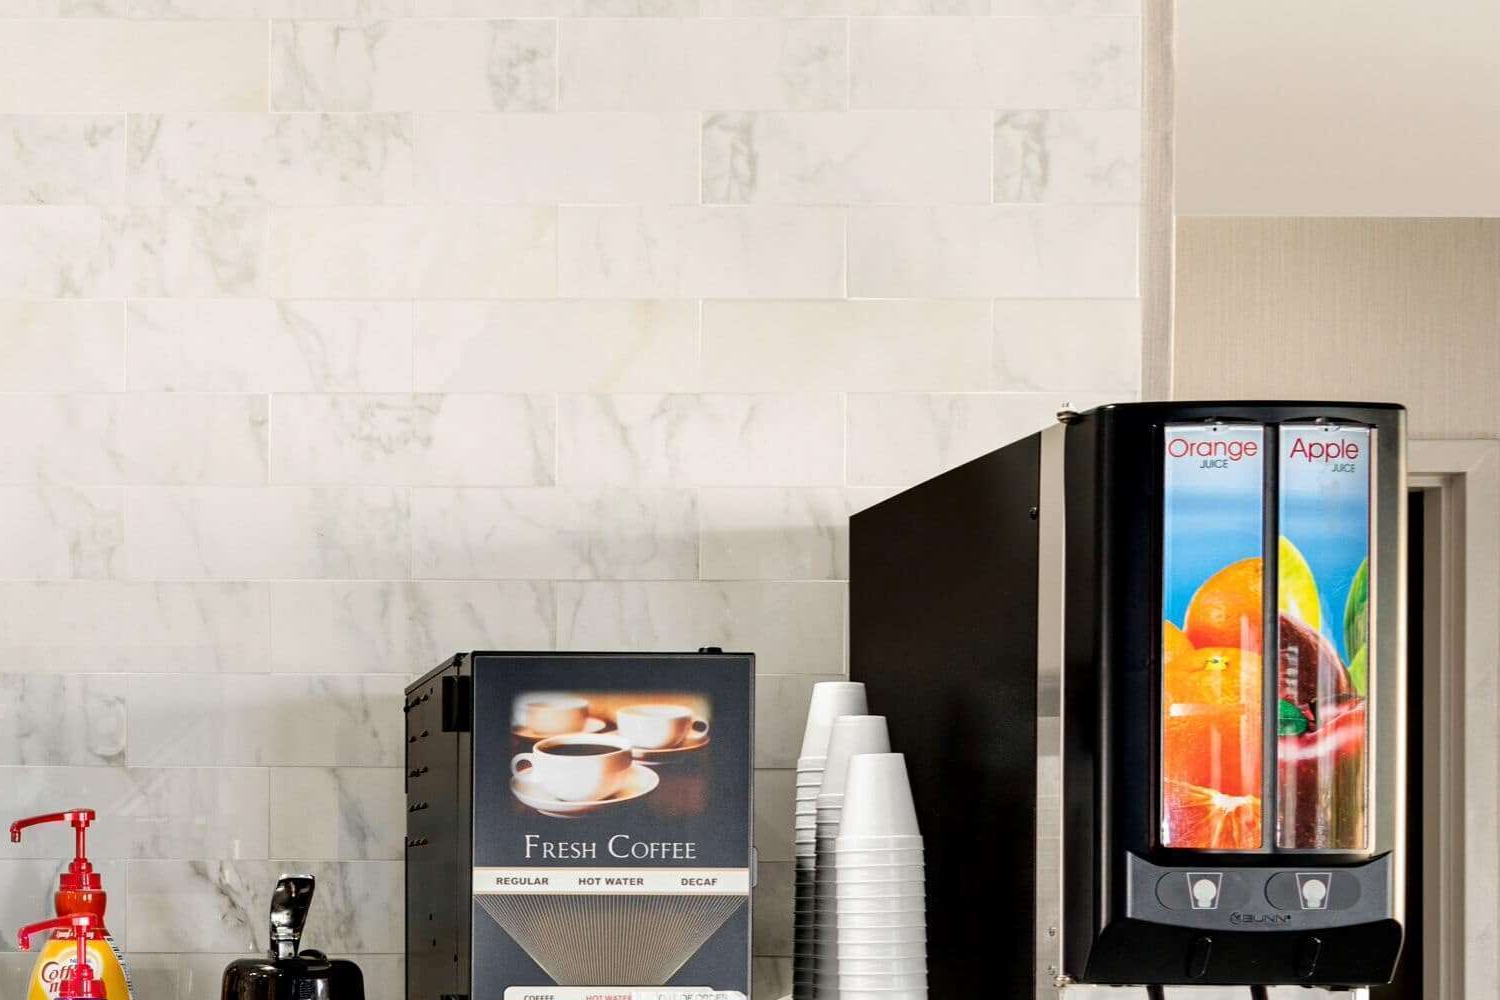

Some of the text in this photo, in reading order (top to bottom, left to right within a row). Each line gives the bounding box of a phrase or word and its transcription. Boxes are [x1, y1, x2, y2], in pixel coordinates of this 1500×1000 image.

[1168, 438, 1258, 461] Orange
[1289, 438, 1360, 463] Apple
[1200, 459, 1229, 469] JUICE
[1331, 463, 1356, 473] JUICE
[524, 834, 697, 859] FRESH COFFEE
[496, 877, 718, 886] REGULAR HOT WATER DECAF
